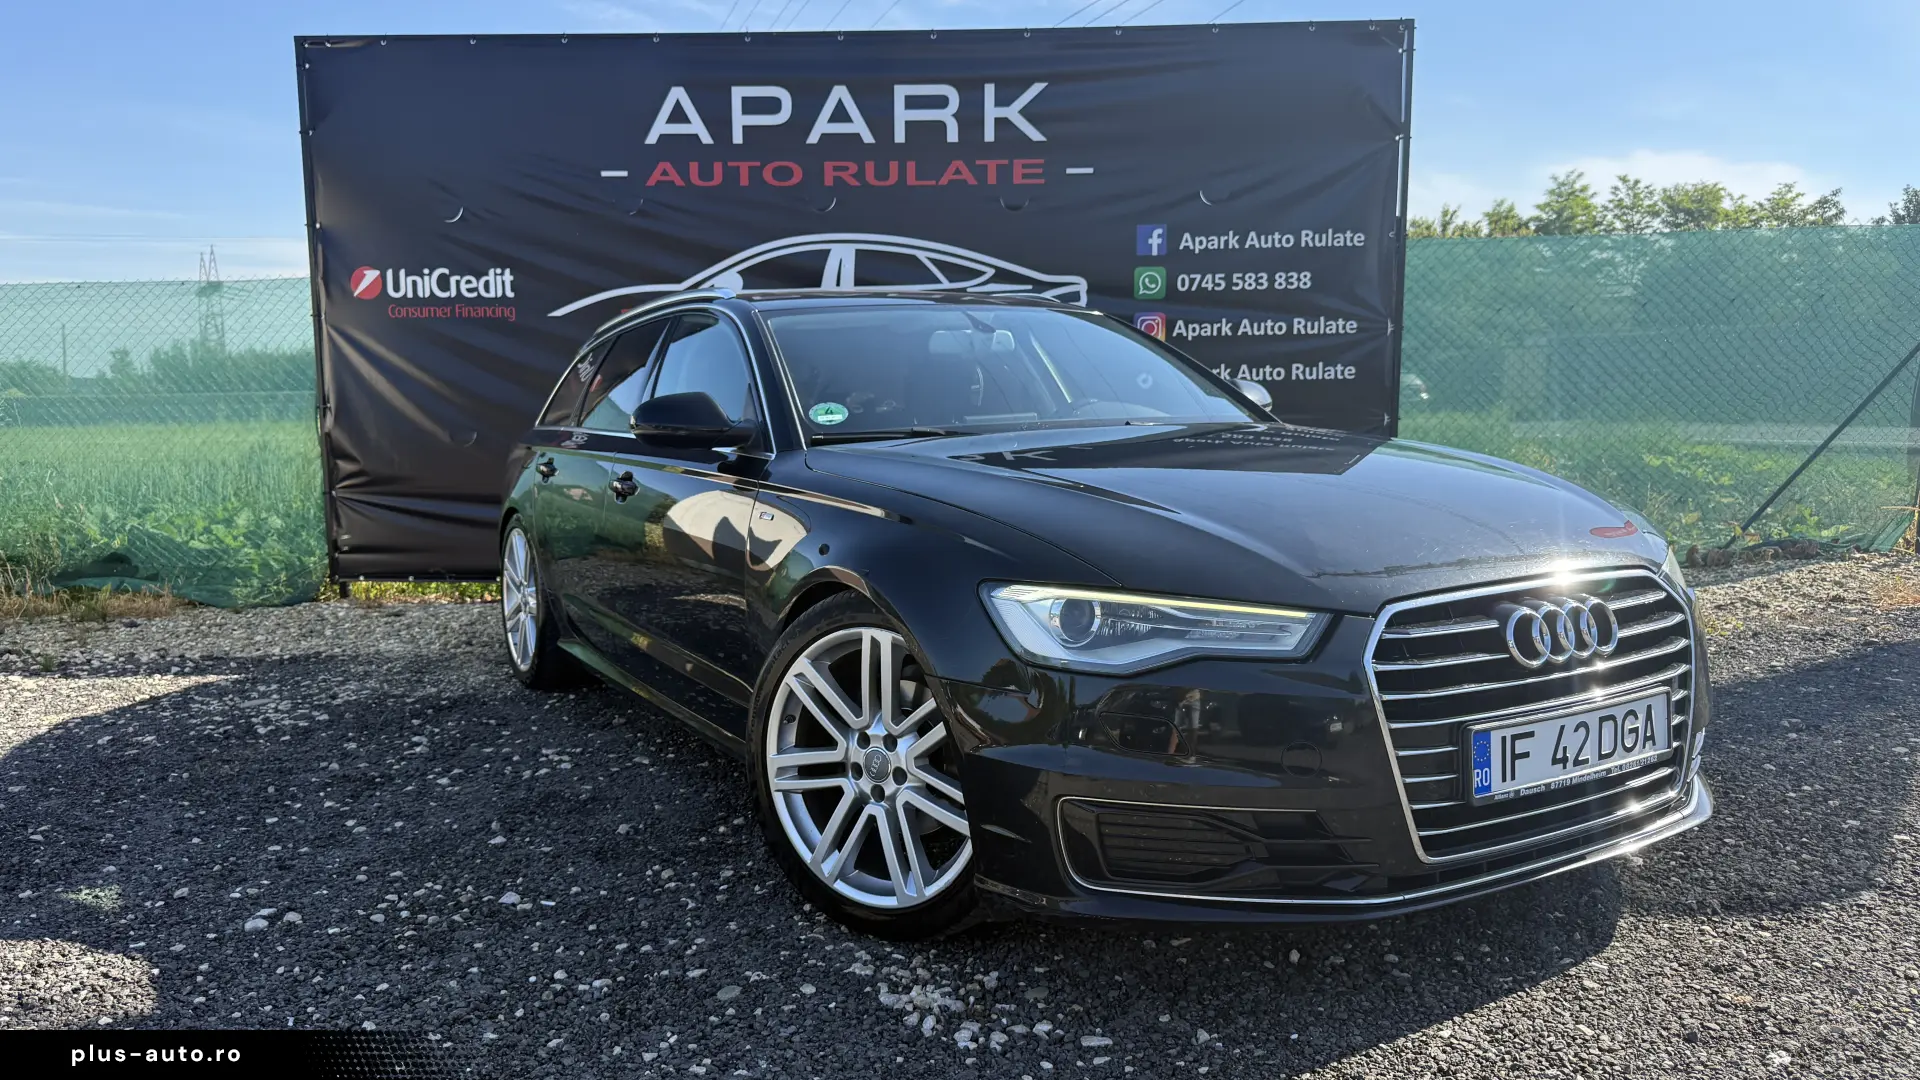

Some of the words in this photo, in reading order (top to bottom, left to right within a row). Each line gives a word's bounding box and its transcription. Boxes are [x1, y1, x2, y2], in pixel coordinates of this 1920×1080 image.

[644, 82, 1049, 145] APARK
[645, 161, 803, 187] AUTO
[823, 159, 1046, 186] RULATE
[1179, 230, 1240, 254] Apark
[1244, 230, 1294, 249] Auto
[1300, 228, 1366, 248] Rulate
[386, 267, 516, 299] UniCredit
[1176, 273, 1227, 292] 0745
[1231, 272, 1269, 291] 583
[1274, 271, 1312, 290] 838
[388, 304, 453, 319] Consumer
[455, 304, 517, 322] Financing
[1172, 318, 1233, 341] Apark
[1237, 318, 1287, 336] Auto
[1293, 316, 1358, 335] Rulate
[1237, 363, 1286, 381] Auto
[1291, 361, 1357, 381] Rulate
[1501, 730, 1536, 783] IF
[1551, 720, 1590, 770] 42
[1598, 703, 1657, 762] DGA
[1474, 767, 1490, 789] RO
[1520, 785, 1546, 796] Dausch
